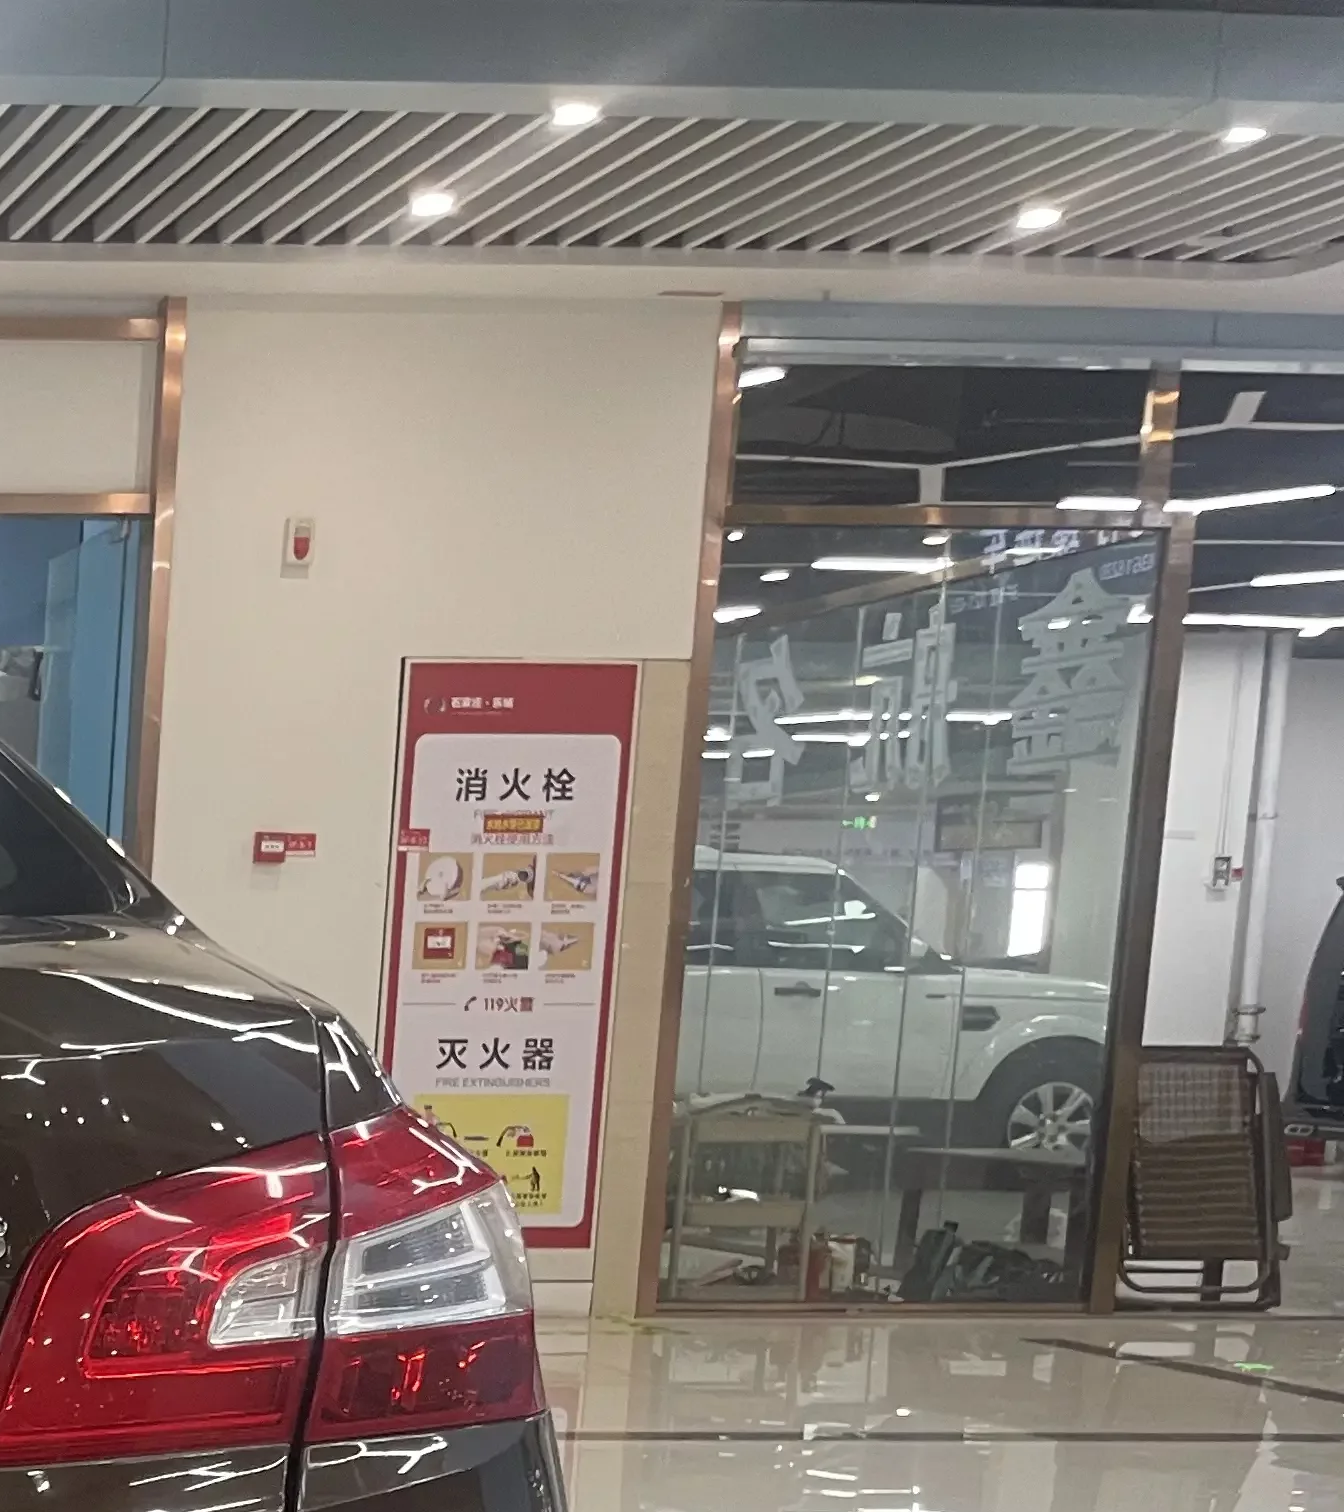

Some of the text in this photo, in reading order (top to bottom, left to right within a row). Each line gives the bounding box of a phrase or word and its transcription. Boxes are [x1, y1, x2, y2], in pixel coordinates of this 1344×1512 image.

[455, 768, 577, 802] 消火栓
[435, 1037, 555, 1072] 灭火器
[435, 1077, 459, 1088] FIRE
